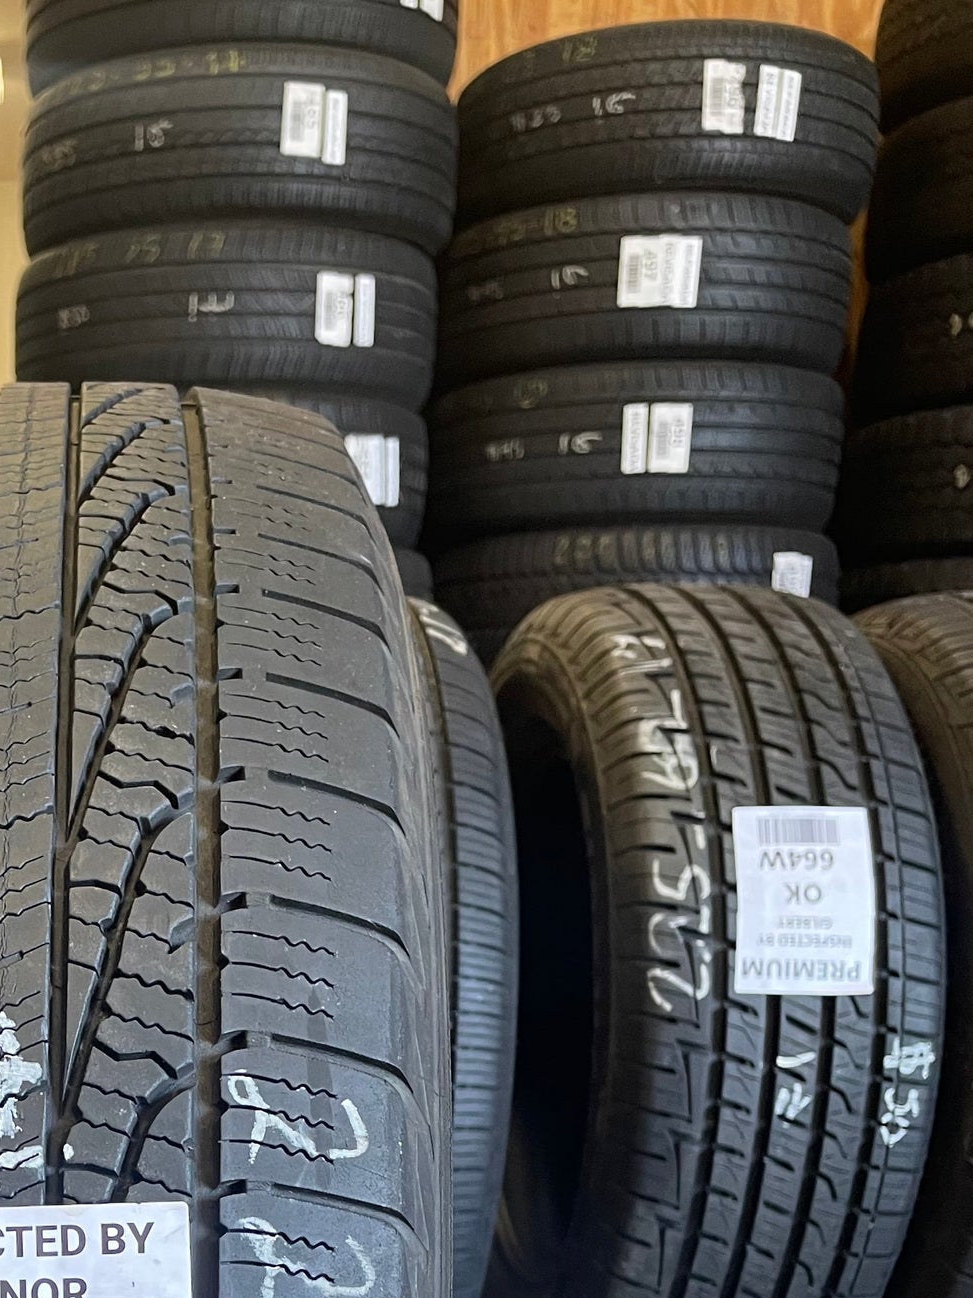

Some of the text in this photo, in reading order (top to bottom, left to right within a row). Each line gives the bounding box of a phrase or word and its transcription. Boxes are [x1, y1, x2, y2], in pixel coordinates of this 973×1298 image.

[759, 849, 834, 871] 664W
[786, 881, 823, 905] OK
[756, 931, 853, 949] INSPECTED BY
[742, 957, 862, 982] PREMIUM
[100, 1221, 156, 1256] BY
